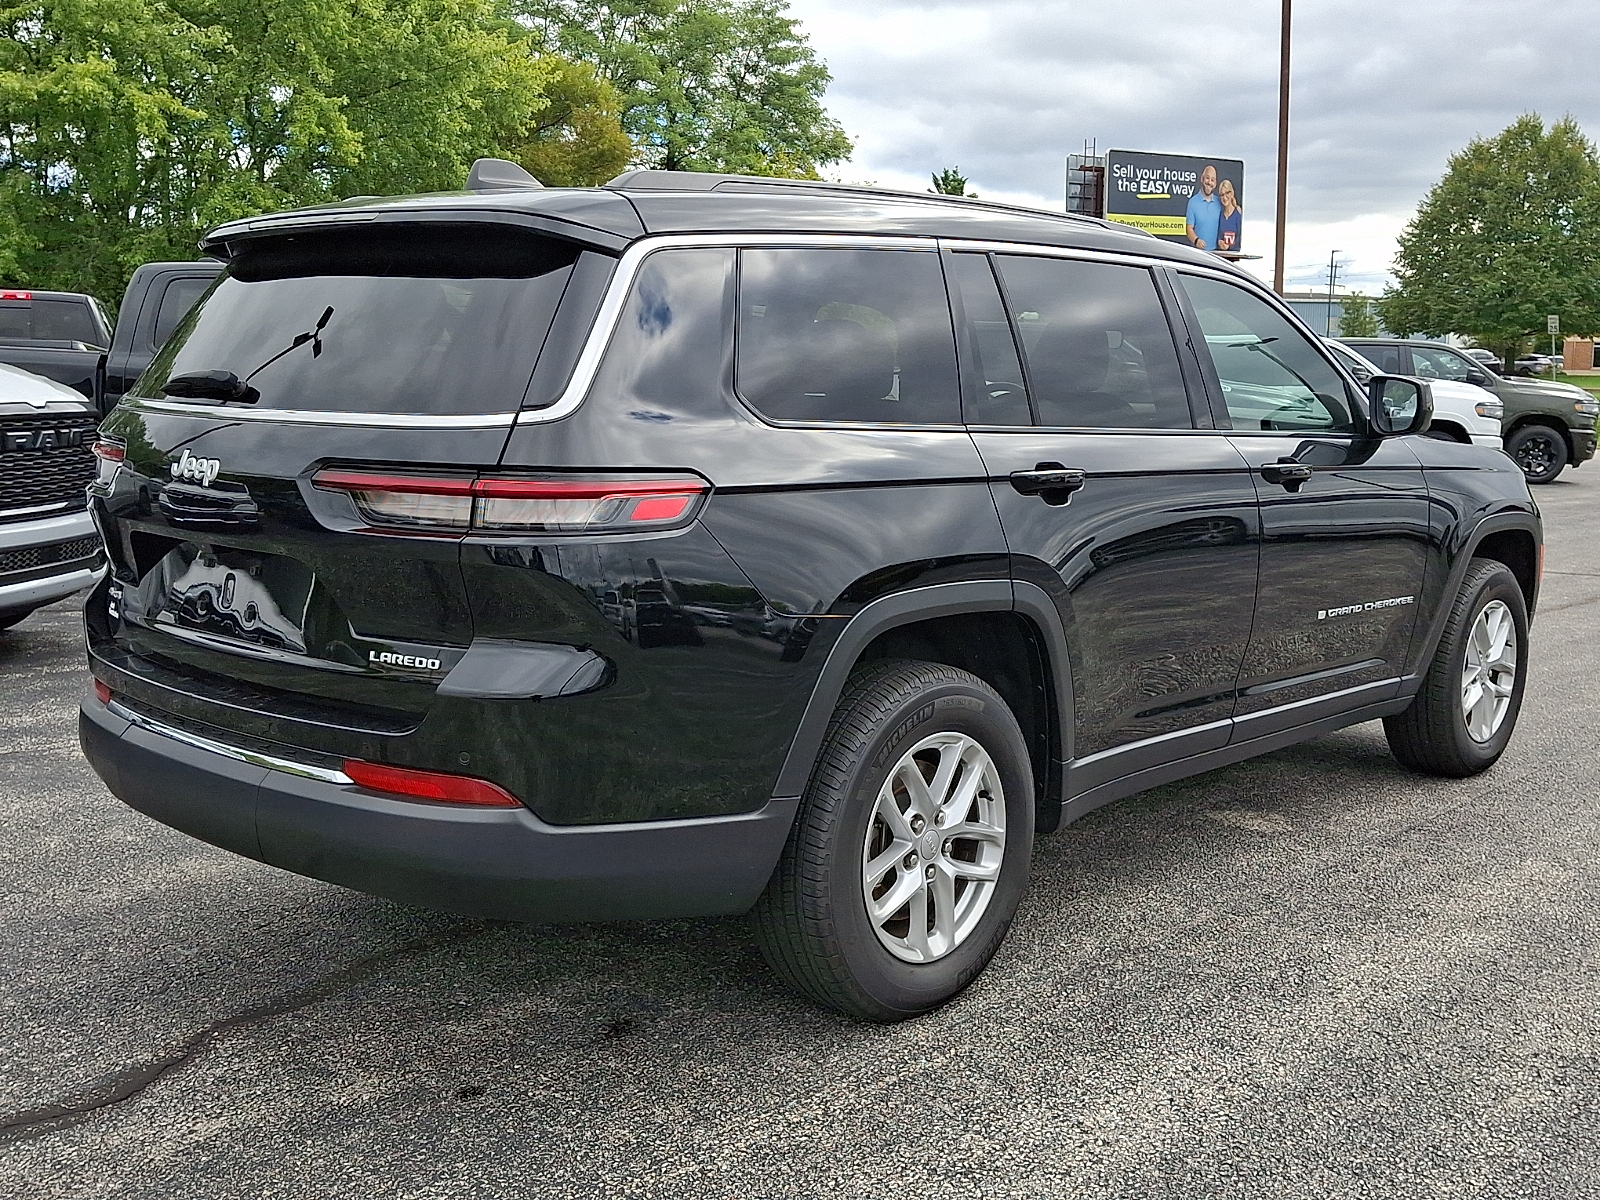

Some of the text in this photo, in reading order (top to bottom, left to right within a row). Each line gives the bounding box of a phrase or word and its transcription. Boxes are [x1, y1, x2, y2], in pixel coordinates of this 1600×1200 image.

[1113, 164, 1197, 182] Sell your house
[1118, 179, 1195, 198] the EASY way
[1224, 235, 1236, 245] TV
[1549, 325, 1558, 333] 25
[171, 449, 220, 487] Jeep
[1328, 596, 1414, 617] GRAND CHEROKEE
[369, 650, 441, 670] LAREDO
[876, 704, 935, 767] MICHELIN
